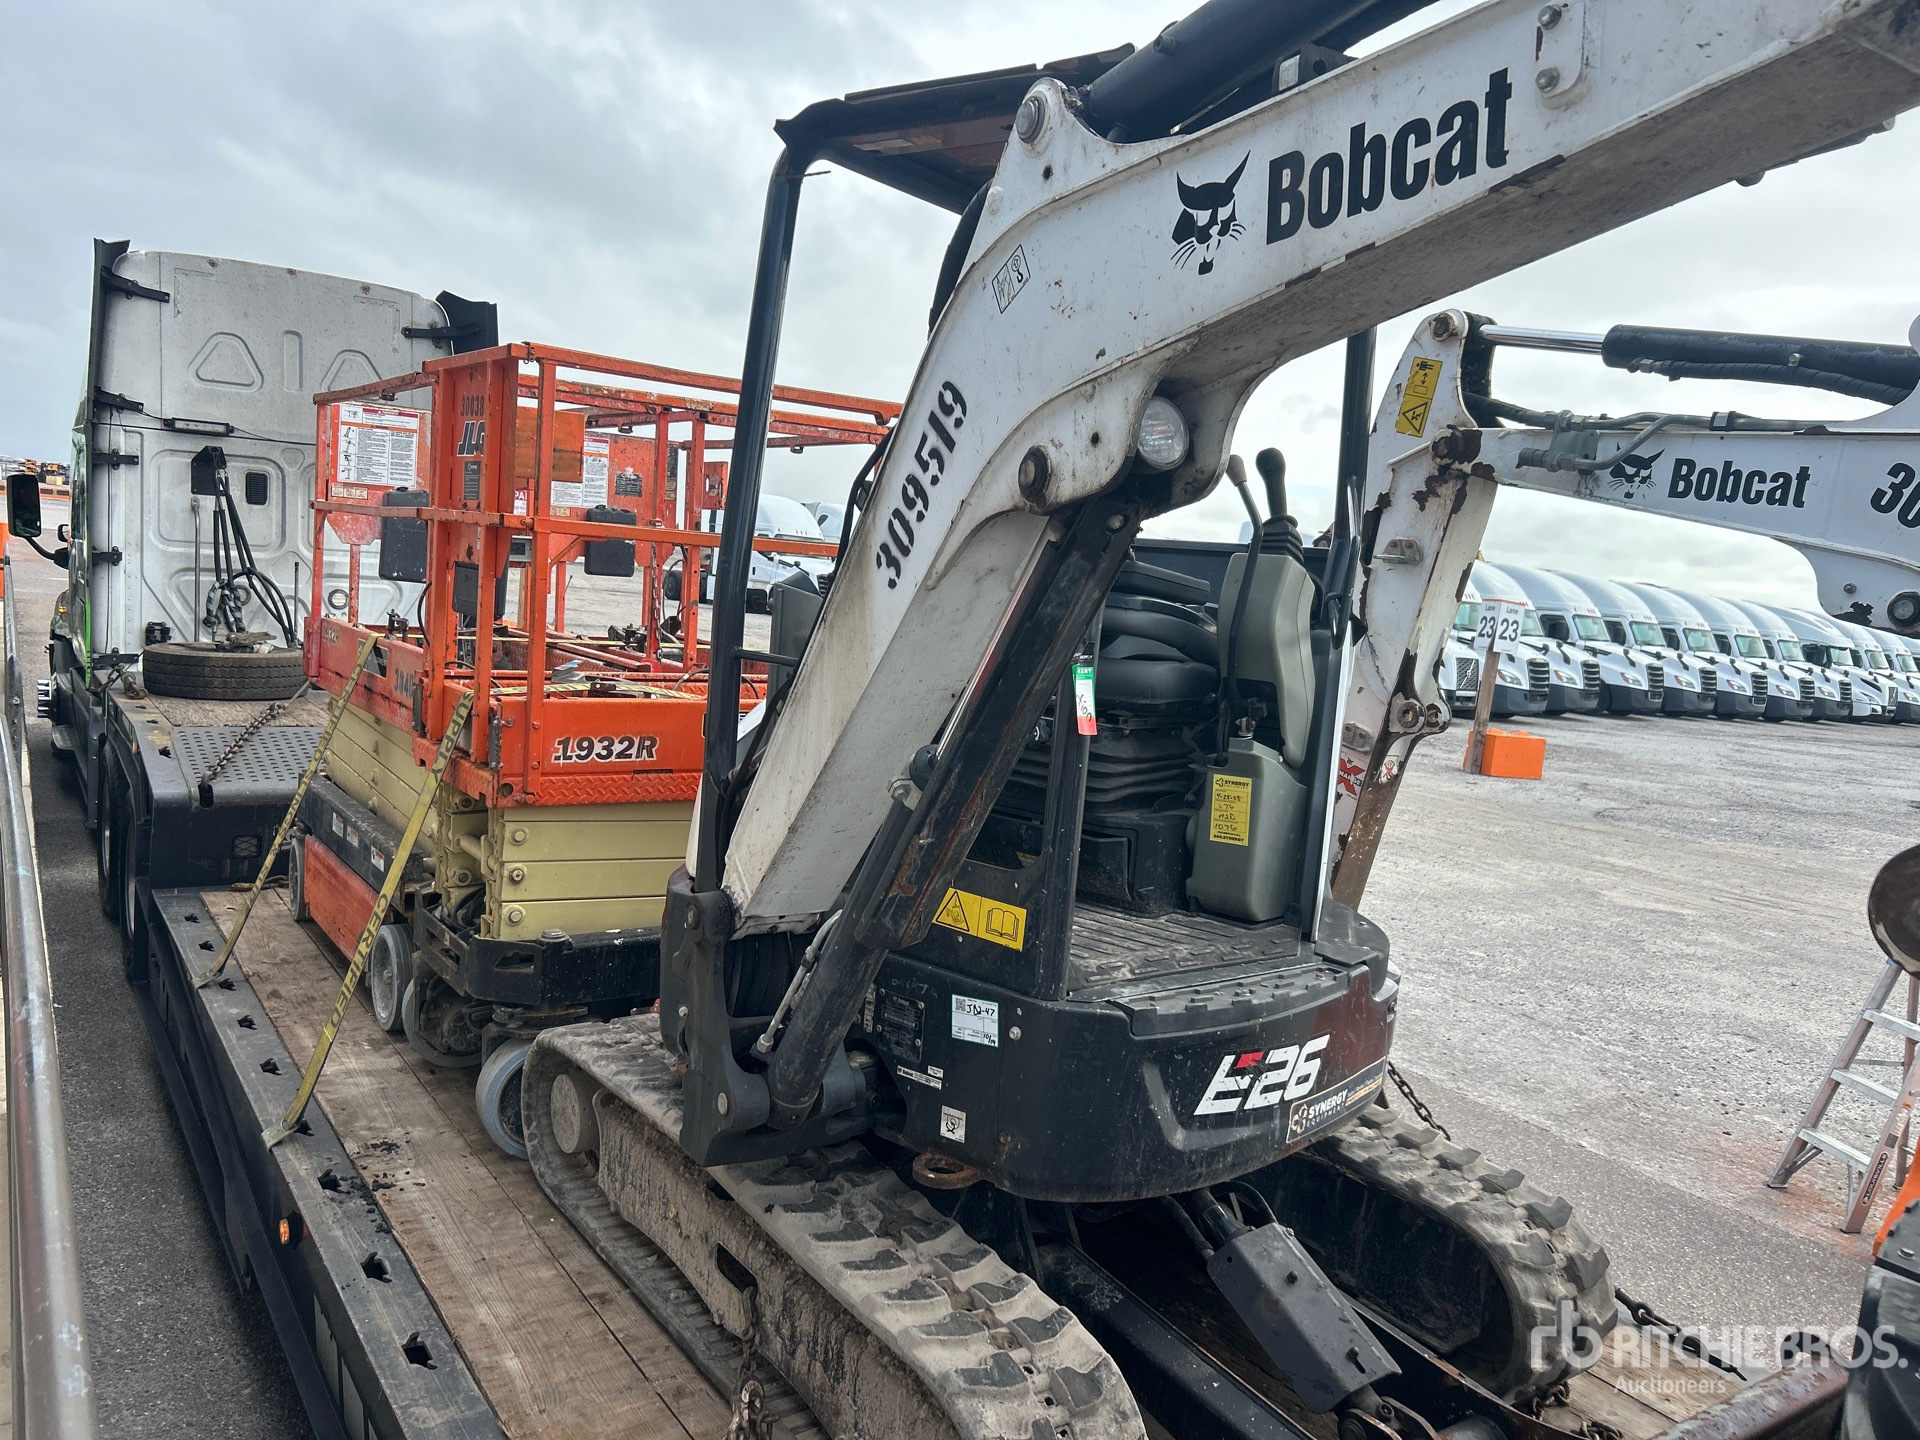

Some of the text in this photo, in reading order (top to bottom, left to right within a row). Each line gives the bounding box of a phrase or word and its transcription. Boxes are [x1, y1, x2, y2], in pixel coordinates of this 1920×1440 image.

[1266, 67, 1512, 245] Bobcat
[457, 420, 485, 457] JLG
[876, 381, 967, 589] 309519
[1668, 458, 1811, 508] Bobcat
[1485, 604, 1496, 612] Lane
[1506, 606, 1519, 615] Lane
[1478, 615, 1496, 639] 23
[1498, 618, 1520, 642] 23
[552, 735, 660, 763] 1932R
[330, 690, 475, 1028] SUPPLY CERTIFIED
[1193, 1034, 1331, 1115] E26
[1306, 1102, 1346, 1127] EQUIPMENT
[1308, 1088, 1349, 1119] SYNERGY
